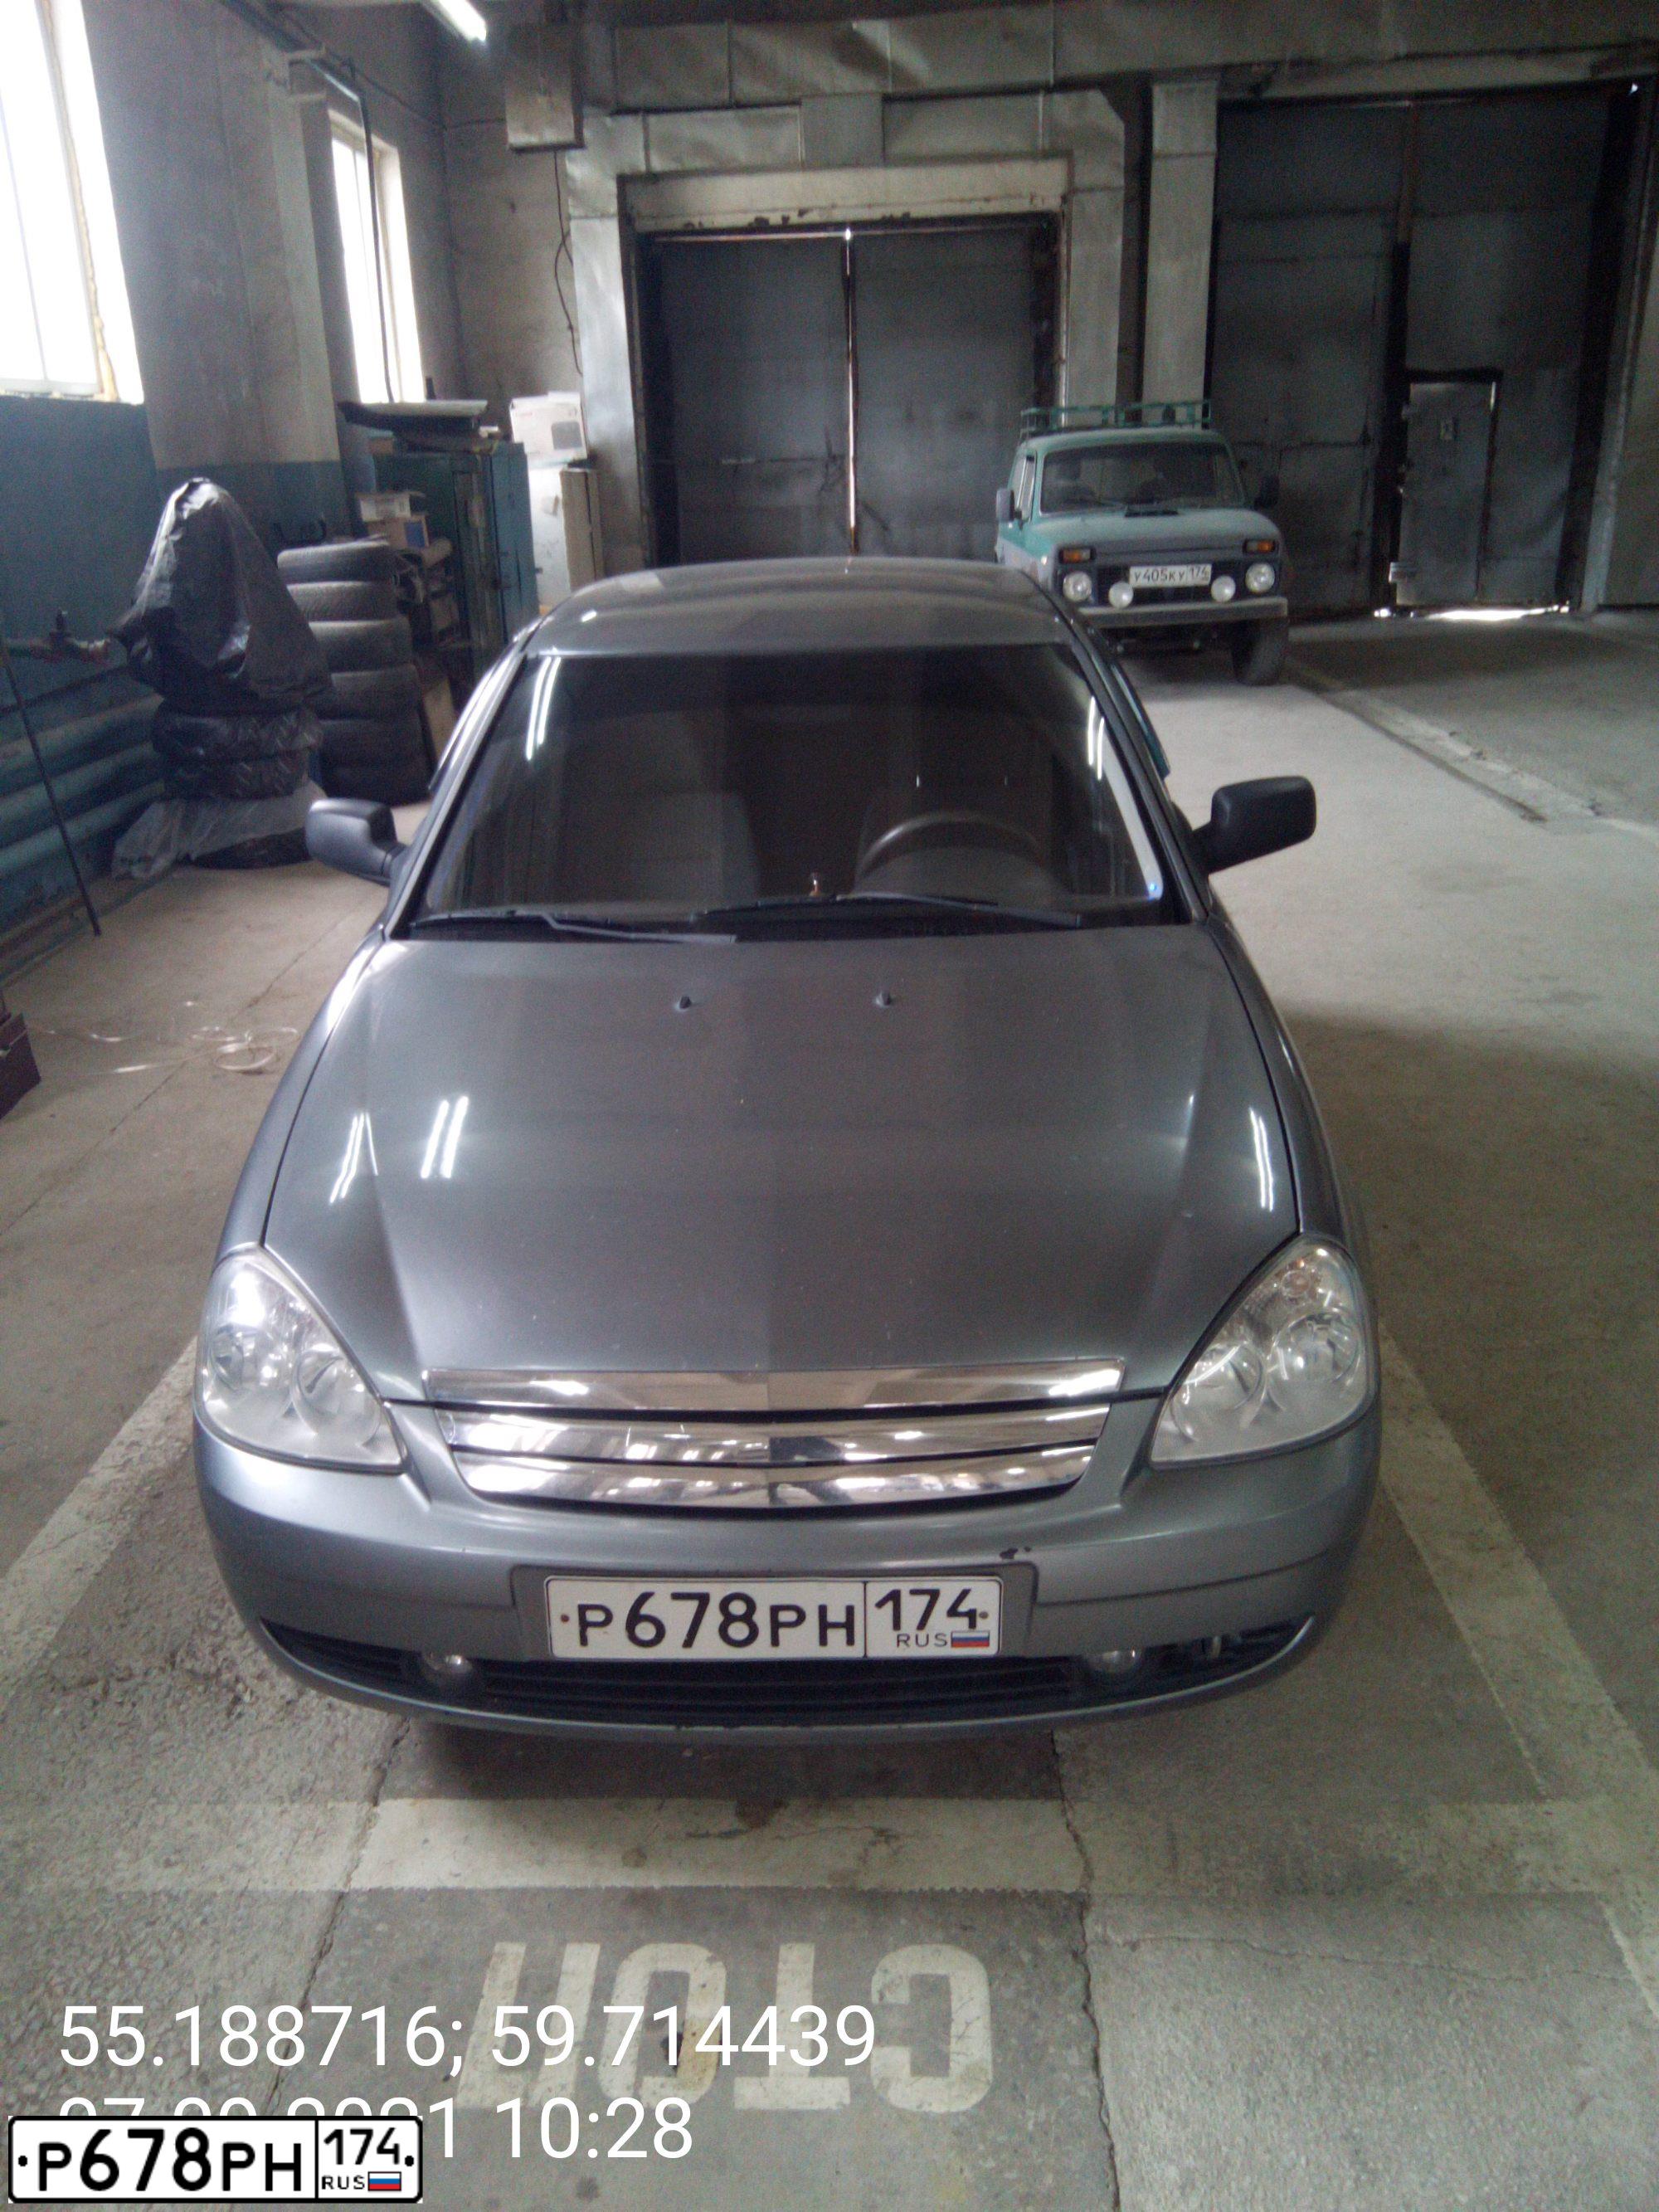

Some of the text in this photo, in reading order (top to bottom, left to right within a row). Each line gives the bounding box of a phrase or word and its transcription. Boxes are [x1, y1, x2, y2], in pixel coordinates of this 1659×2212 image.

[577, 1588, 977, 1649] Р678РН 174
[896, 1630, 947, 1649] RUS
